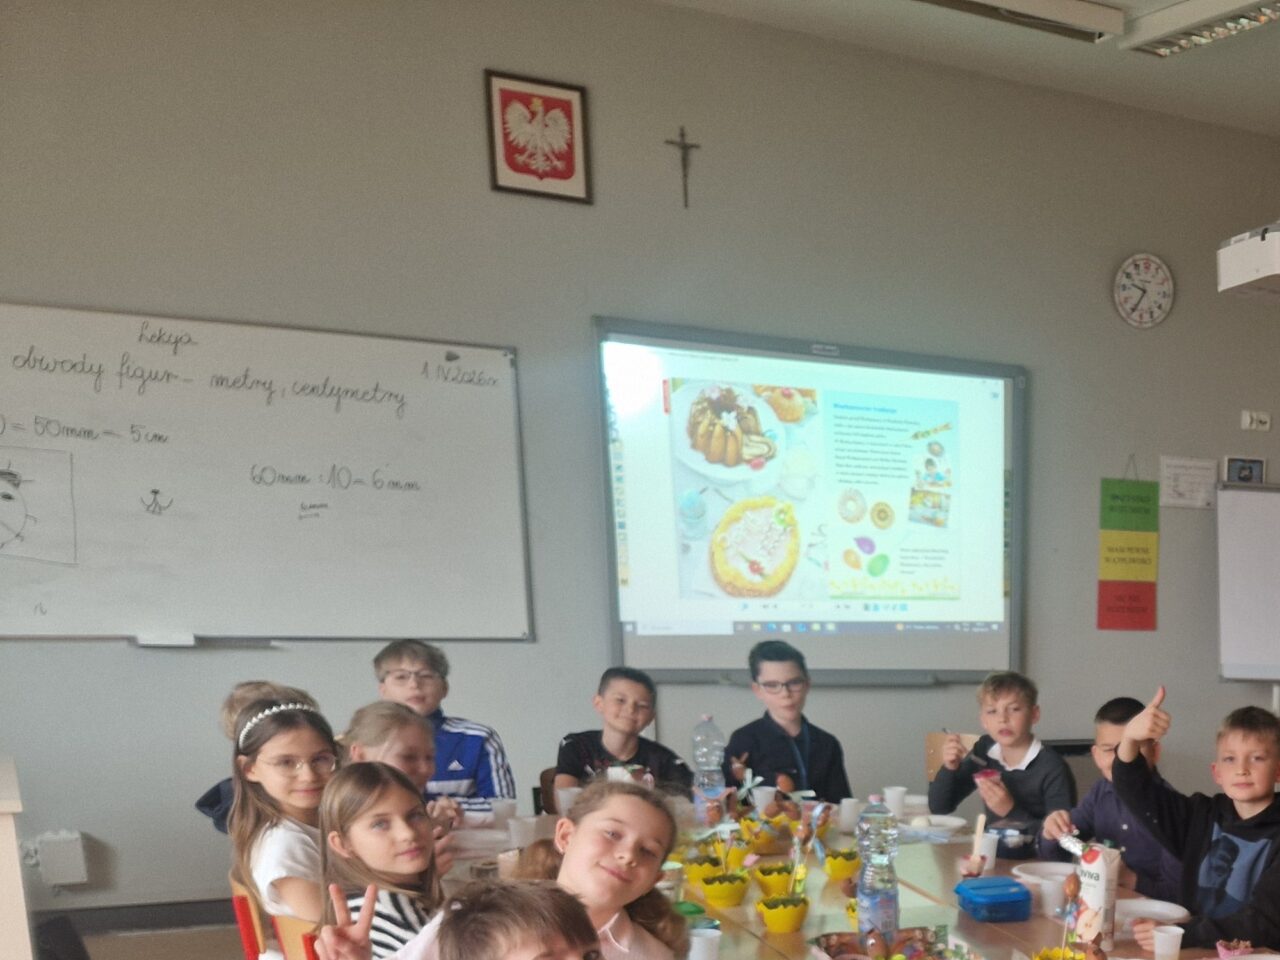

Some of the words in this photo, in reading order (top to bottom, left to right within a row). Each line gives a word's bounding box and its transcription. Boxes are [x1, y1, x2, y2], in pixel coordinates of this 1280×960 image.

[12, 345, 104, 394] obwody
[115, 352, 178, 395] figur
[292, 376, 406, 420] centymetry
